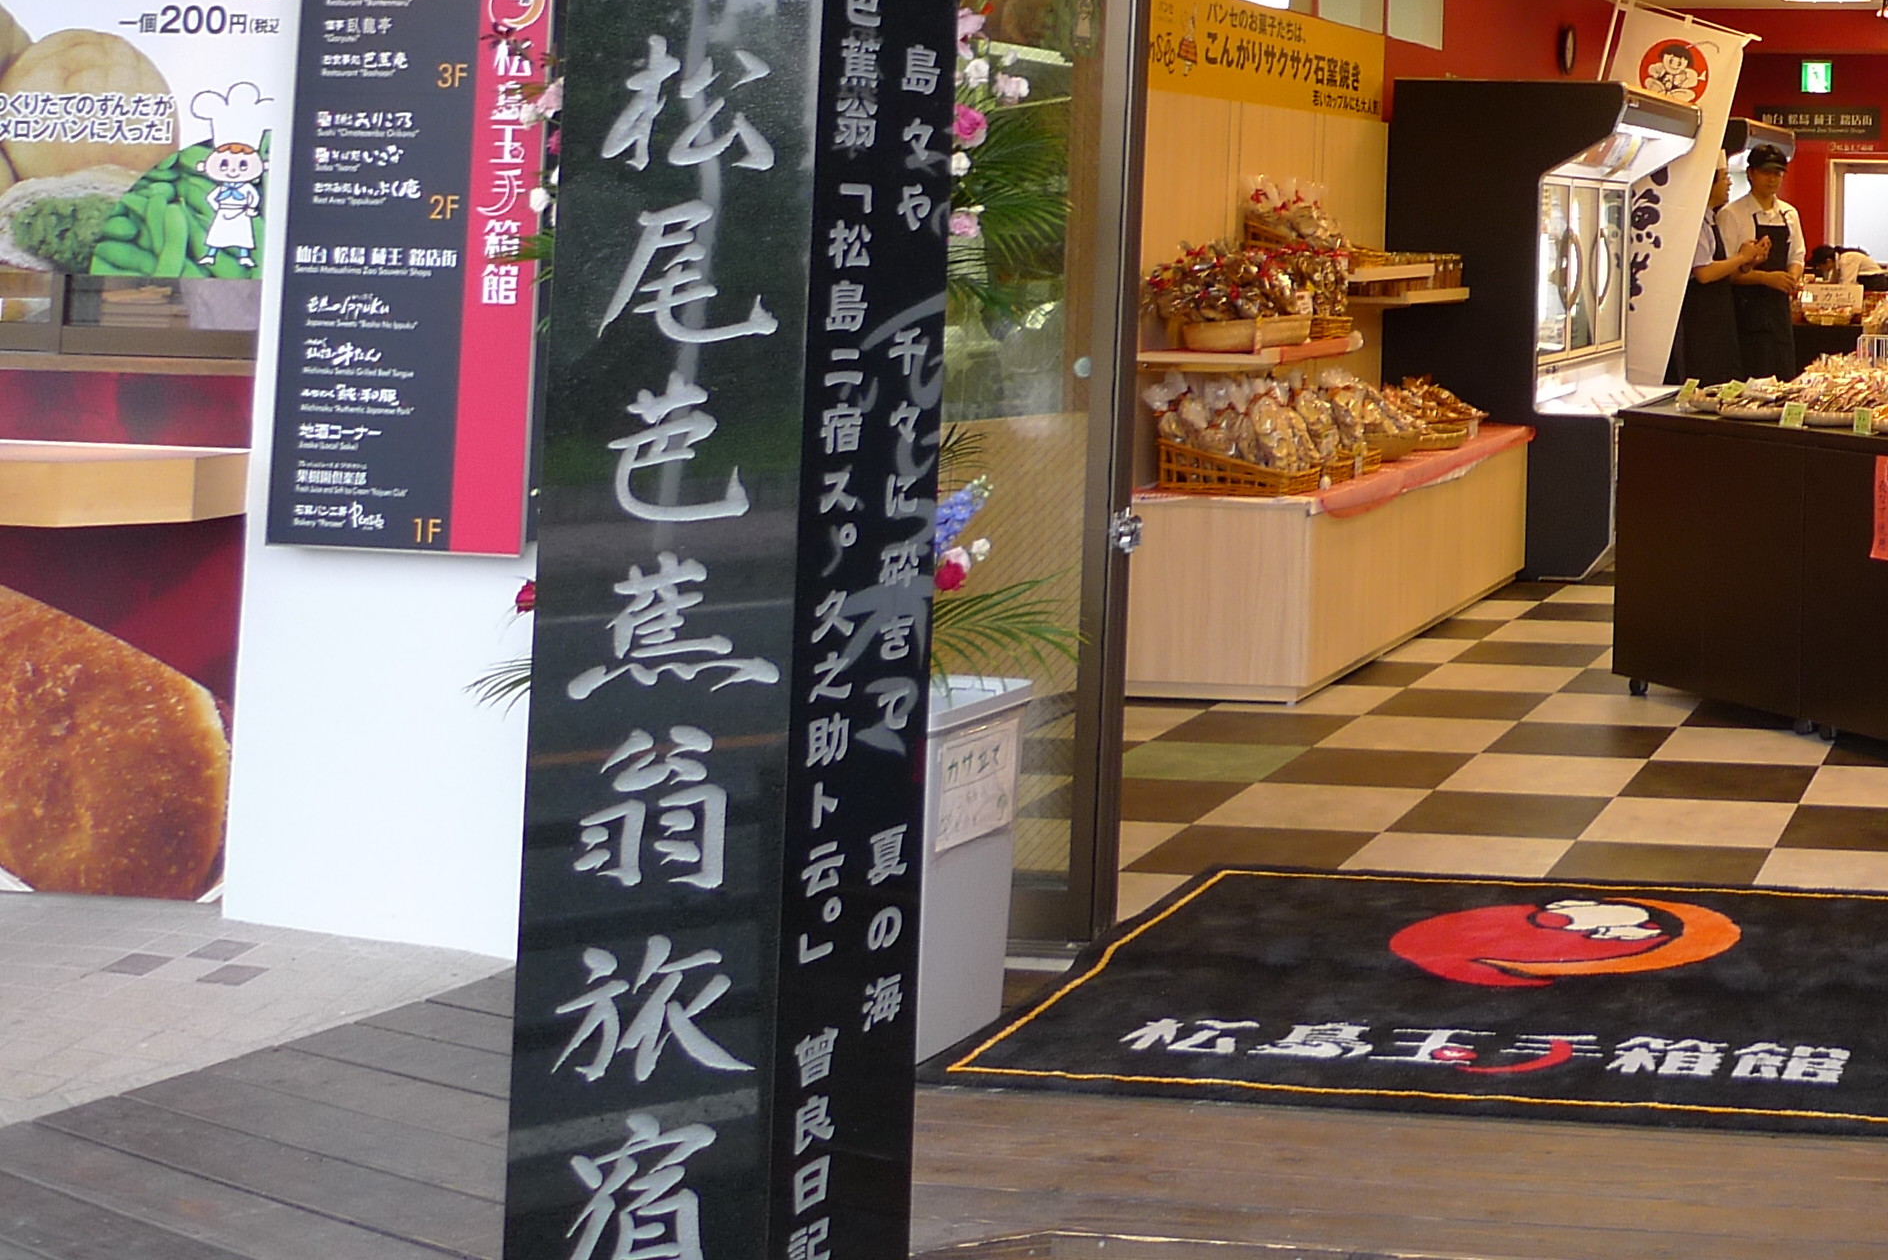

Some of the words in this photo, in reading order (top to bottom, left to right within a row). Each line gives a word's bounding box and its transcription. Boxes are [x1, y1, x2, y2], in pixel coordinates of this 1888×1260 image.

[1206, 2, 1307, 44] パンセのお菓子たちは、
[1205, 31, 1361, 92] こんがりサクサク石窯焼き
[437, 63, 468, 87] 3F
[429, 195, 460, 219] 2F
[295, 245, 327, 264] 仙台
[333, 246, 366, 265] 松島
[299, 422, 383, 440] 地酒コーナー
[413, 518, 442, 543] 1F
[551, 34, 780, 1260] 松尾芭蕉翁旅宿
[1119, 1017, 1853, 1086] 松島玉手箱館
